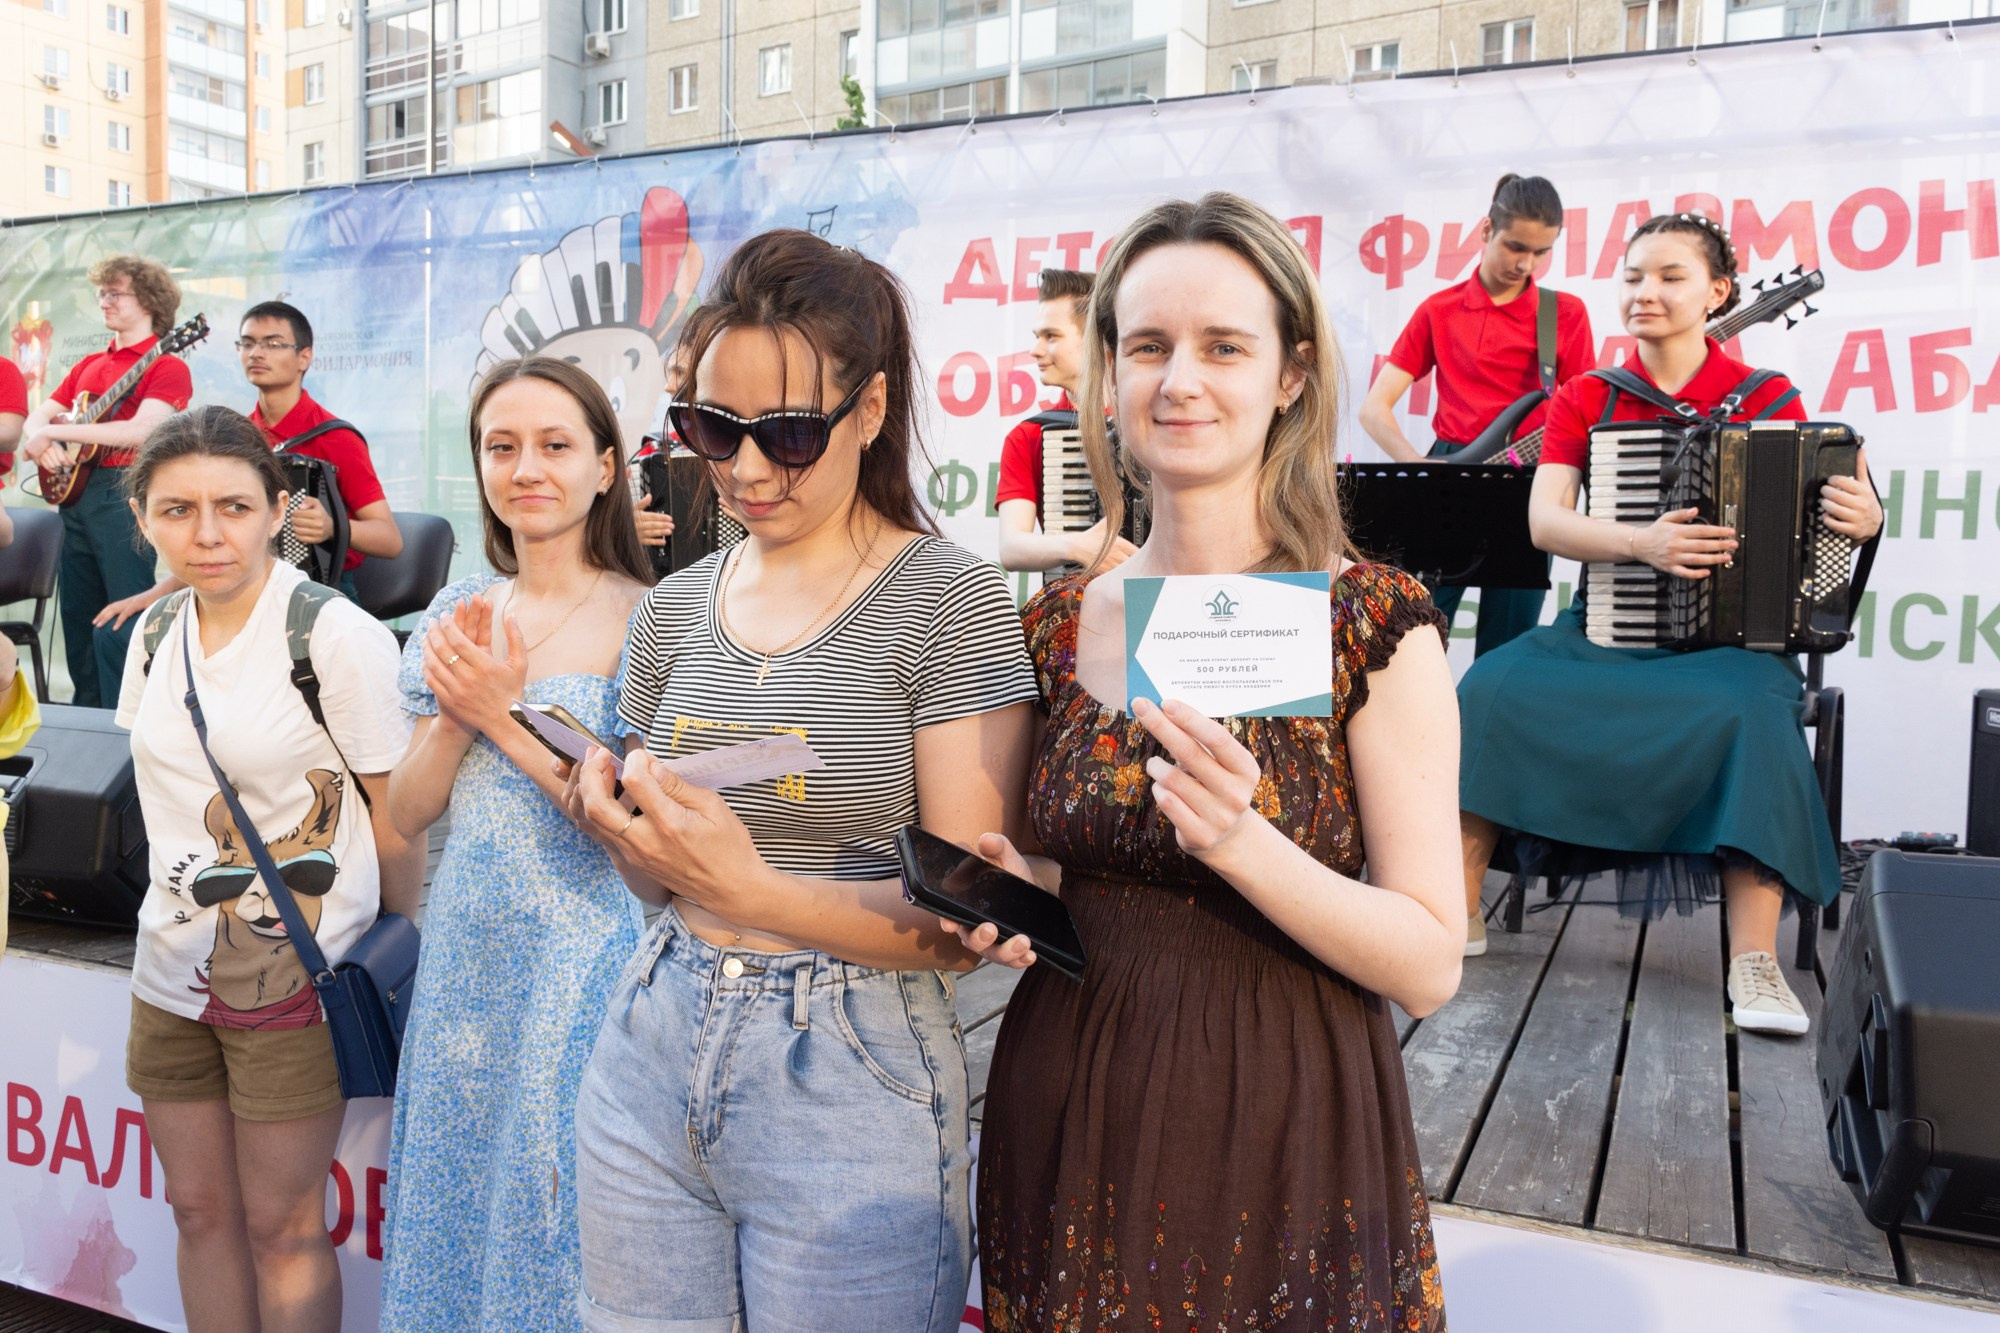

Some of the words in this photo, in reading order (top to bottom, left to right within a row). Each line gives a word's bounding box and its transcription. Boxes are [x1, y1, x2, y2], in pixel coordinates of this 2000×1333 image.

[943, 215, 1322, 307] ДЕТЯ
[311, 351, 412, 371] ФИЛАРМОНИЯ
[1153, 628, 1228, 641] ПОДАРОЧНЫЙ
[1230, 628, 1300, 639] СЕРТИФИКАТ
[1219, 664, 1258, 673] РУБЛЕЙ
[7, 1081, 172, 1205] ВАЛ
